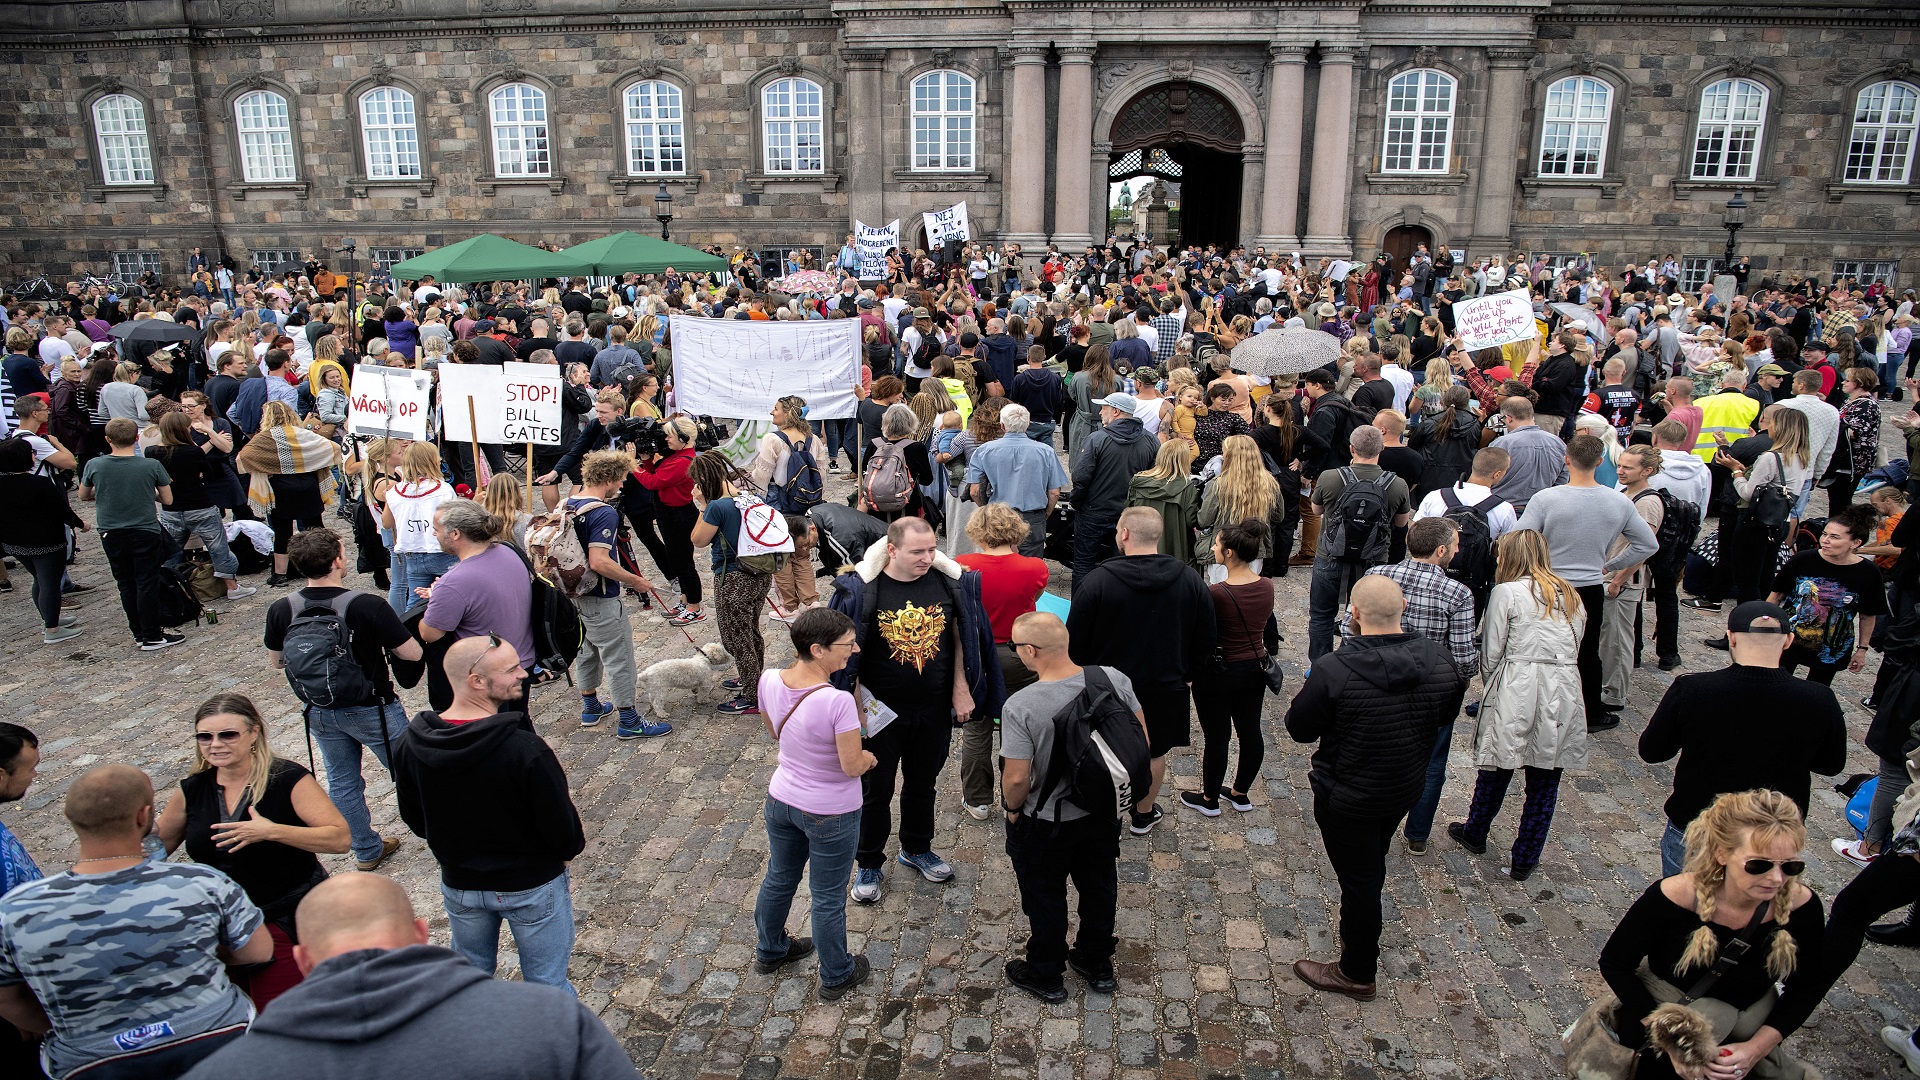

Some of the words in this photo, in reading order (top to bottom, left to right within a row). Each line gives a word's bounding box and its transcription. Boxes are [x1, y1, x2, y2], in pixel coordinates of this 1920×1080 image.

[935, 209, 953, 223] NEJ
[862, 225, 890, 236] FJERN
[1495, 298, 1513, 311] you
[1491, 327, 1508, 339] you
[506, 383, 557, 404] STOP!
[399, 402, 418, 417] OP
[506, 407, 542, 423] BILL
[504, 424, 560, 442] GATES
[747, 544, 764, 553] STOP
